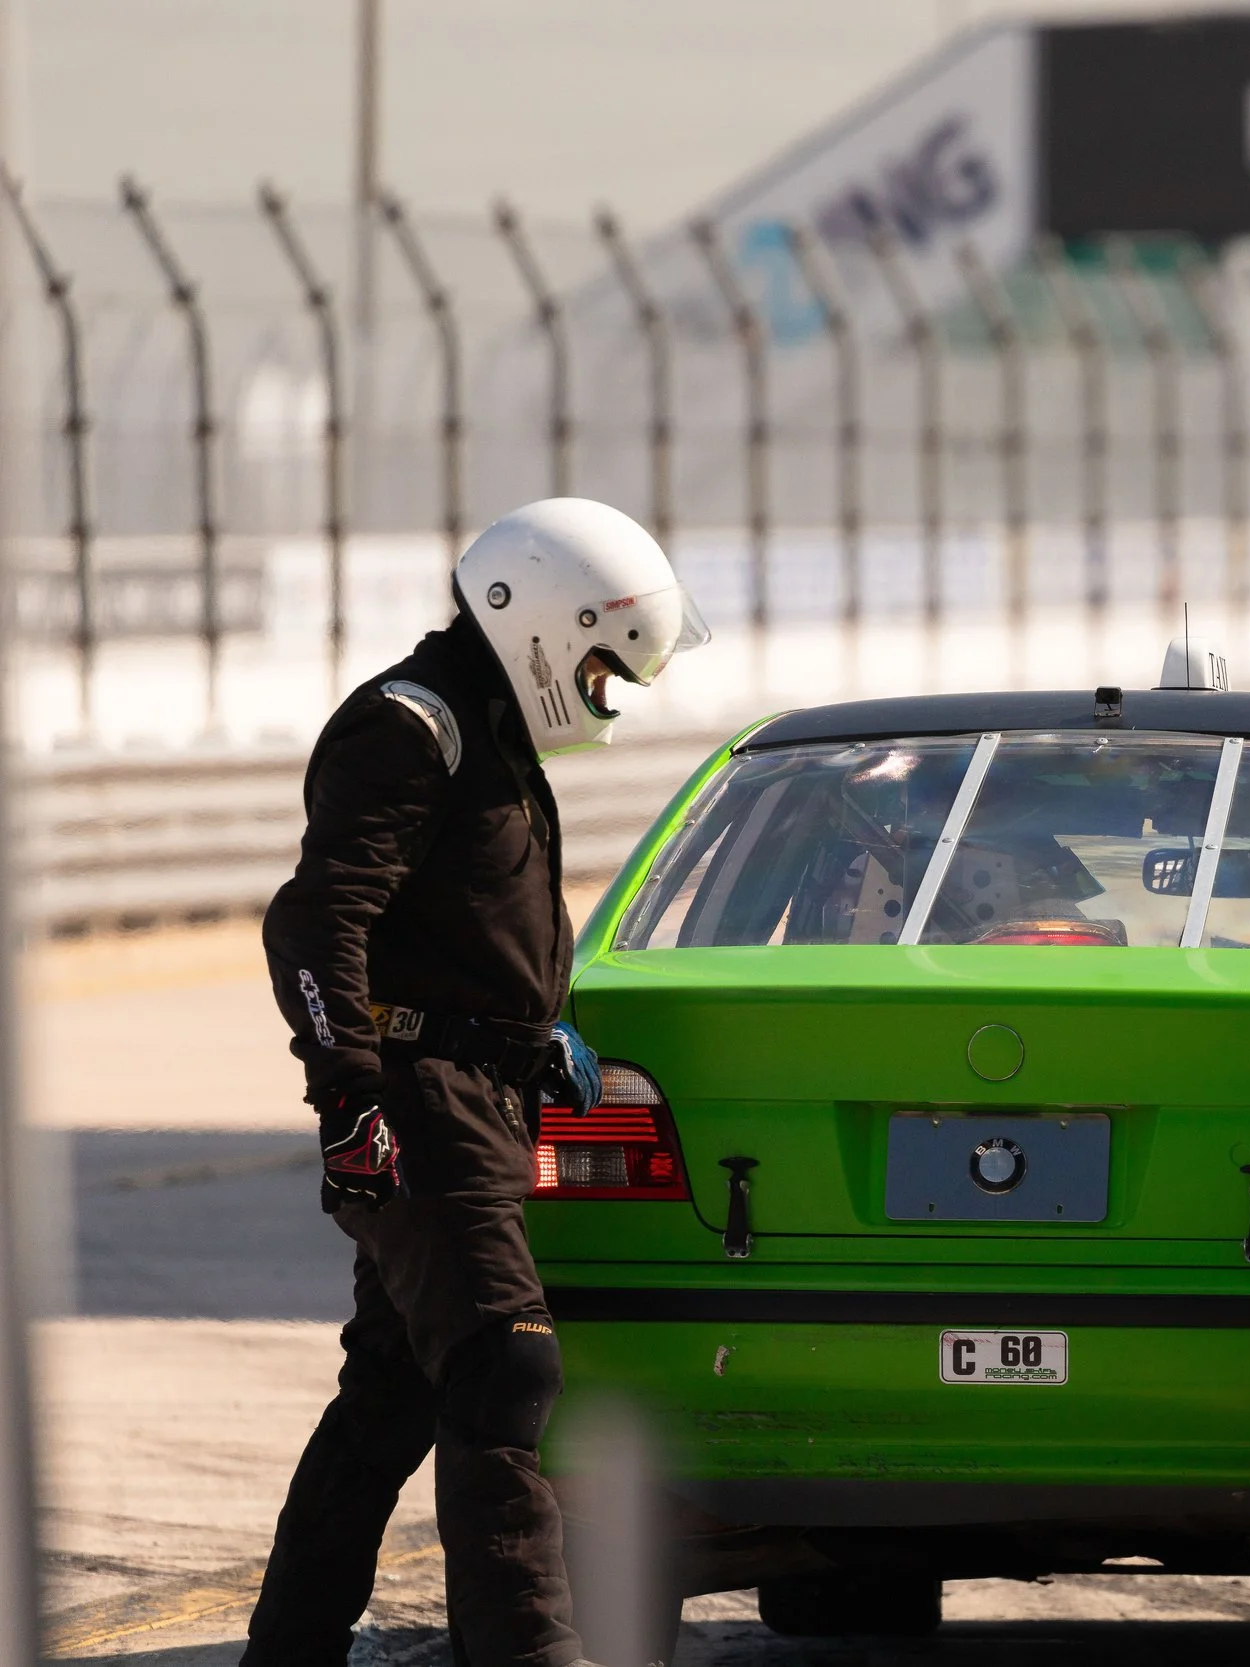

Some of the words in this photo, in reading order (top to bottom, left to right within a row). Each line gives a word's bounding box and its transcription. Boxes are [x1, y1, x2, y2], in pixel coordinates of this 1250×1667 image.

[974, 1138, 1022, 1156] BMW
[952, 1339, 976, 1376] C
[1000, 1335, 1042, 1367] 60
